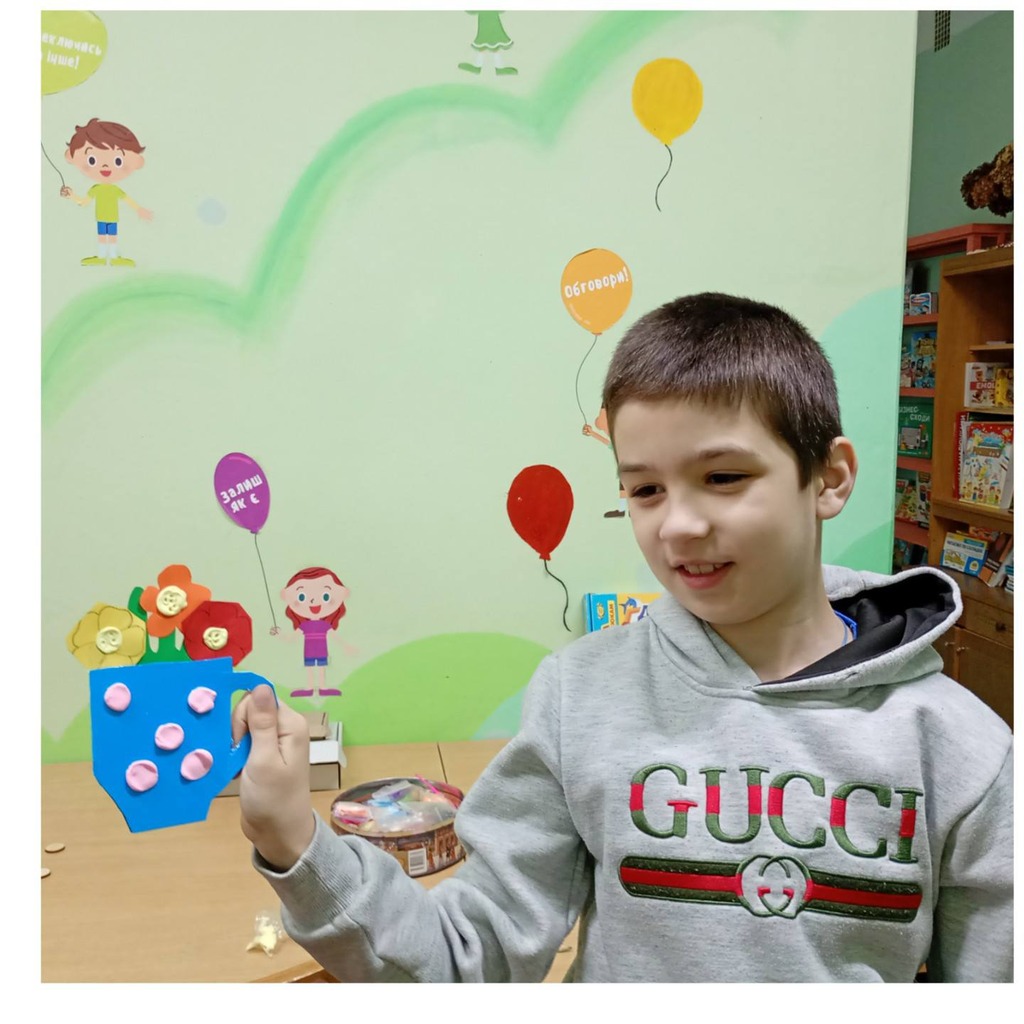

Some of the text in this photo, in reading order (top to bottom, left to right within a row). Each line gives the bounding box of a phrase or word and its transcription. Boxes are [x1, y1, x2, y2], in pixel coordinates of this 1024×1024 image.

[563, 265, 630, 299] Обговори!
[220, 474, 263, 504] Залиш
[230, 497, 247, 514] як
[629, 762, 924, 864] GUCCI
